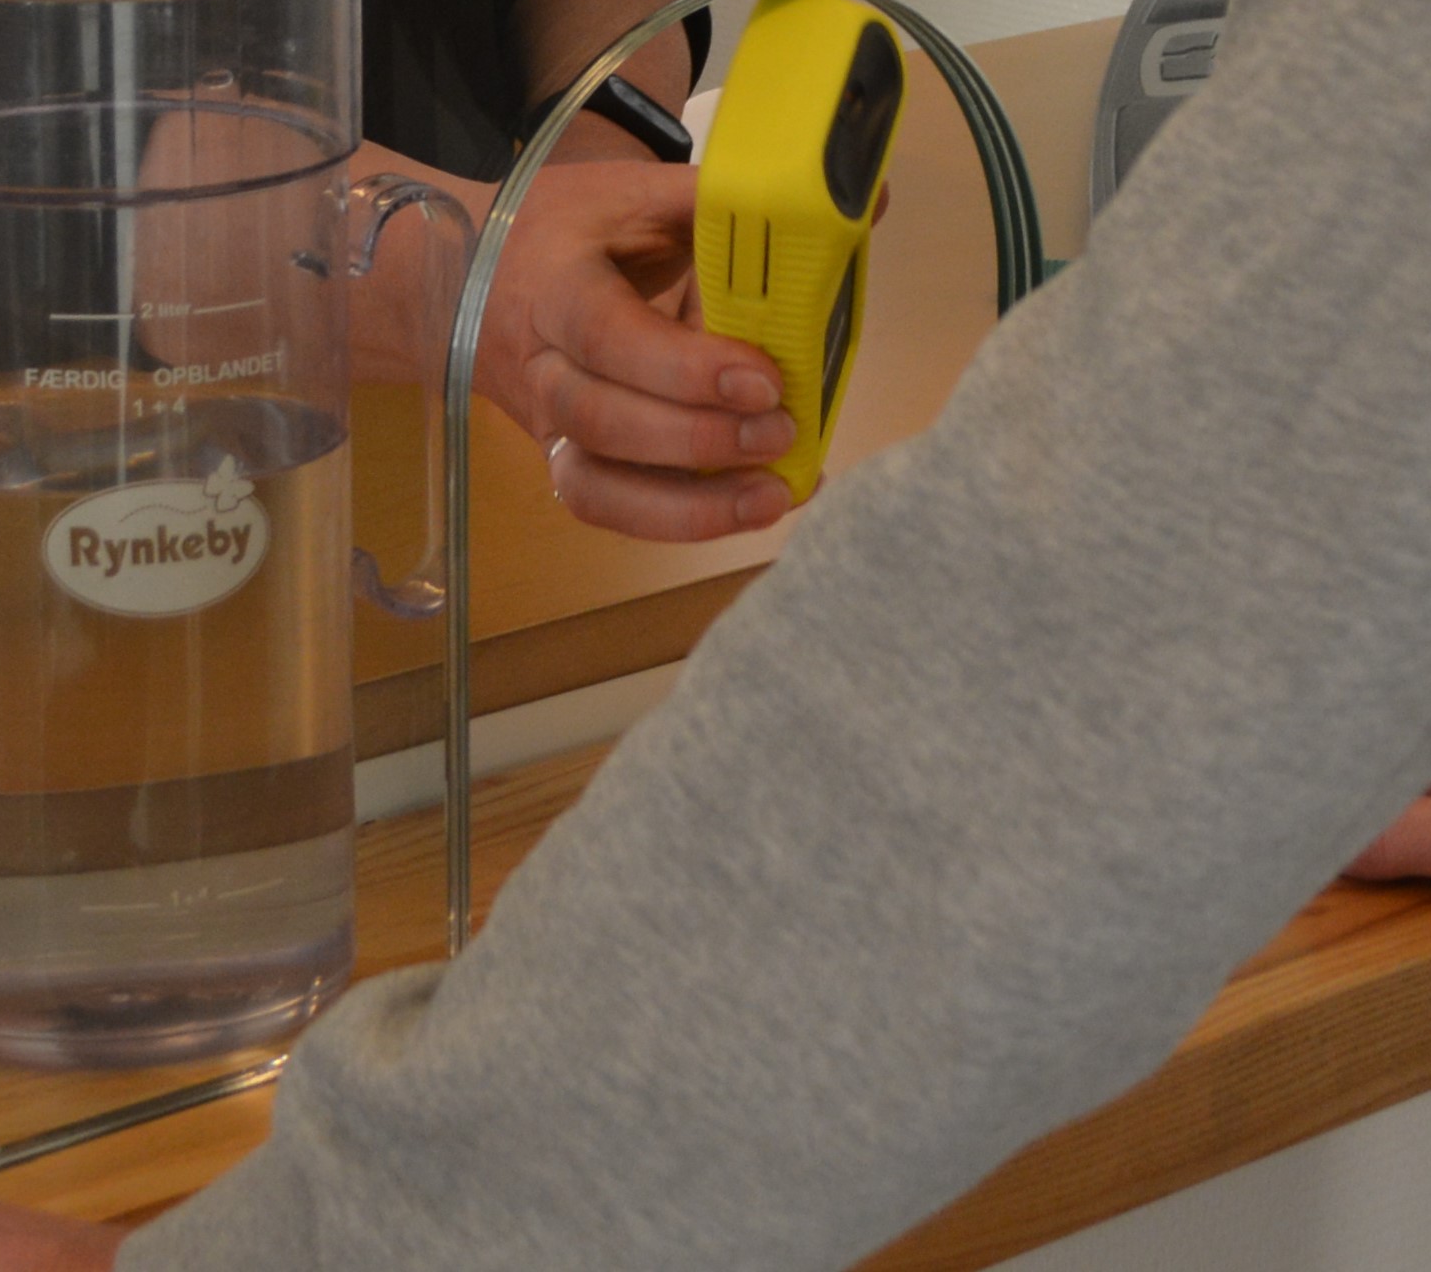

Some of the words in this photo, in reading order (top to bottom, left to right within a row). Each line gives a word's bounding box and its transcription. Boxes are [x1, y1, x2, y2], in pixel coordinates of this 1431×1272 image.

[141, 302, 153, 320] 2
[158, 302, 192, 319] liter
[24, 367, 126, 390] FÆRDIG
[152, 349, 285, 388] OPBLANDET
[132, 397, 144, 418] 1
[151, 401, 166, 415] +
[171, 396, 186, 416] 4
[69, 520, 253, 578] Rynkeby
